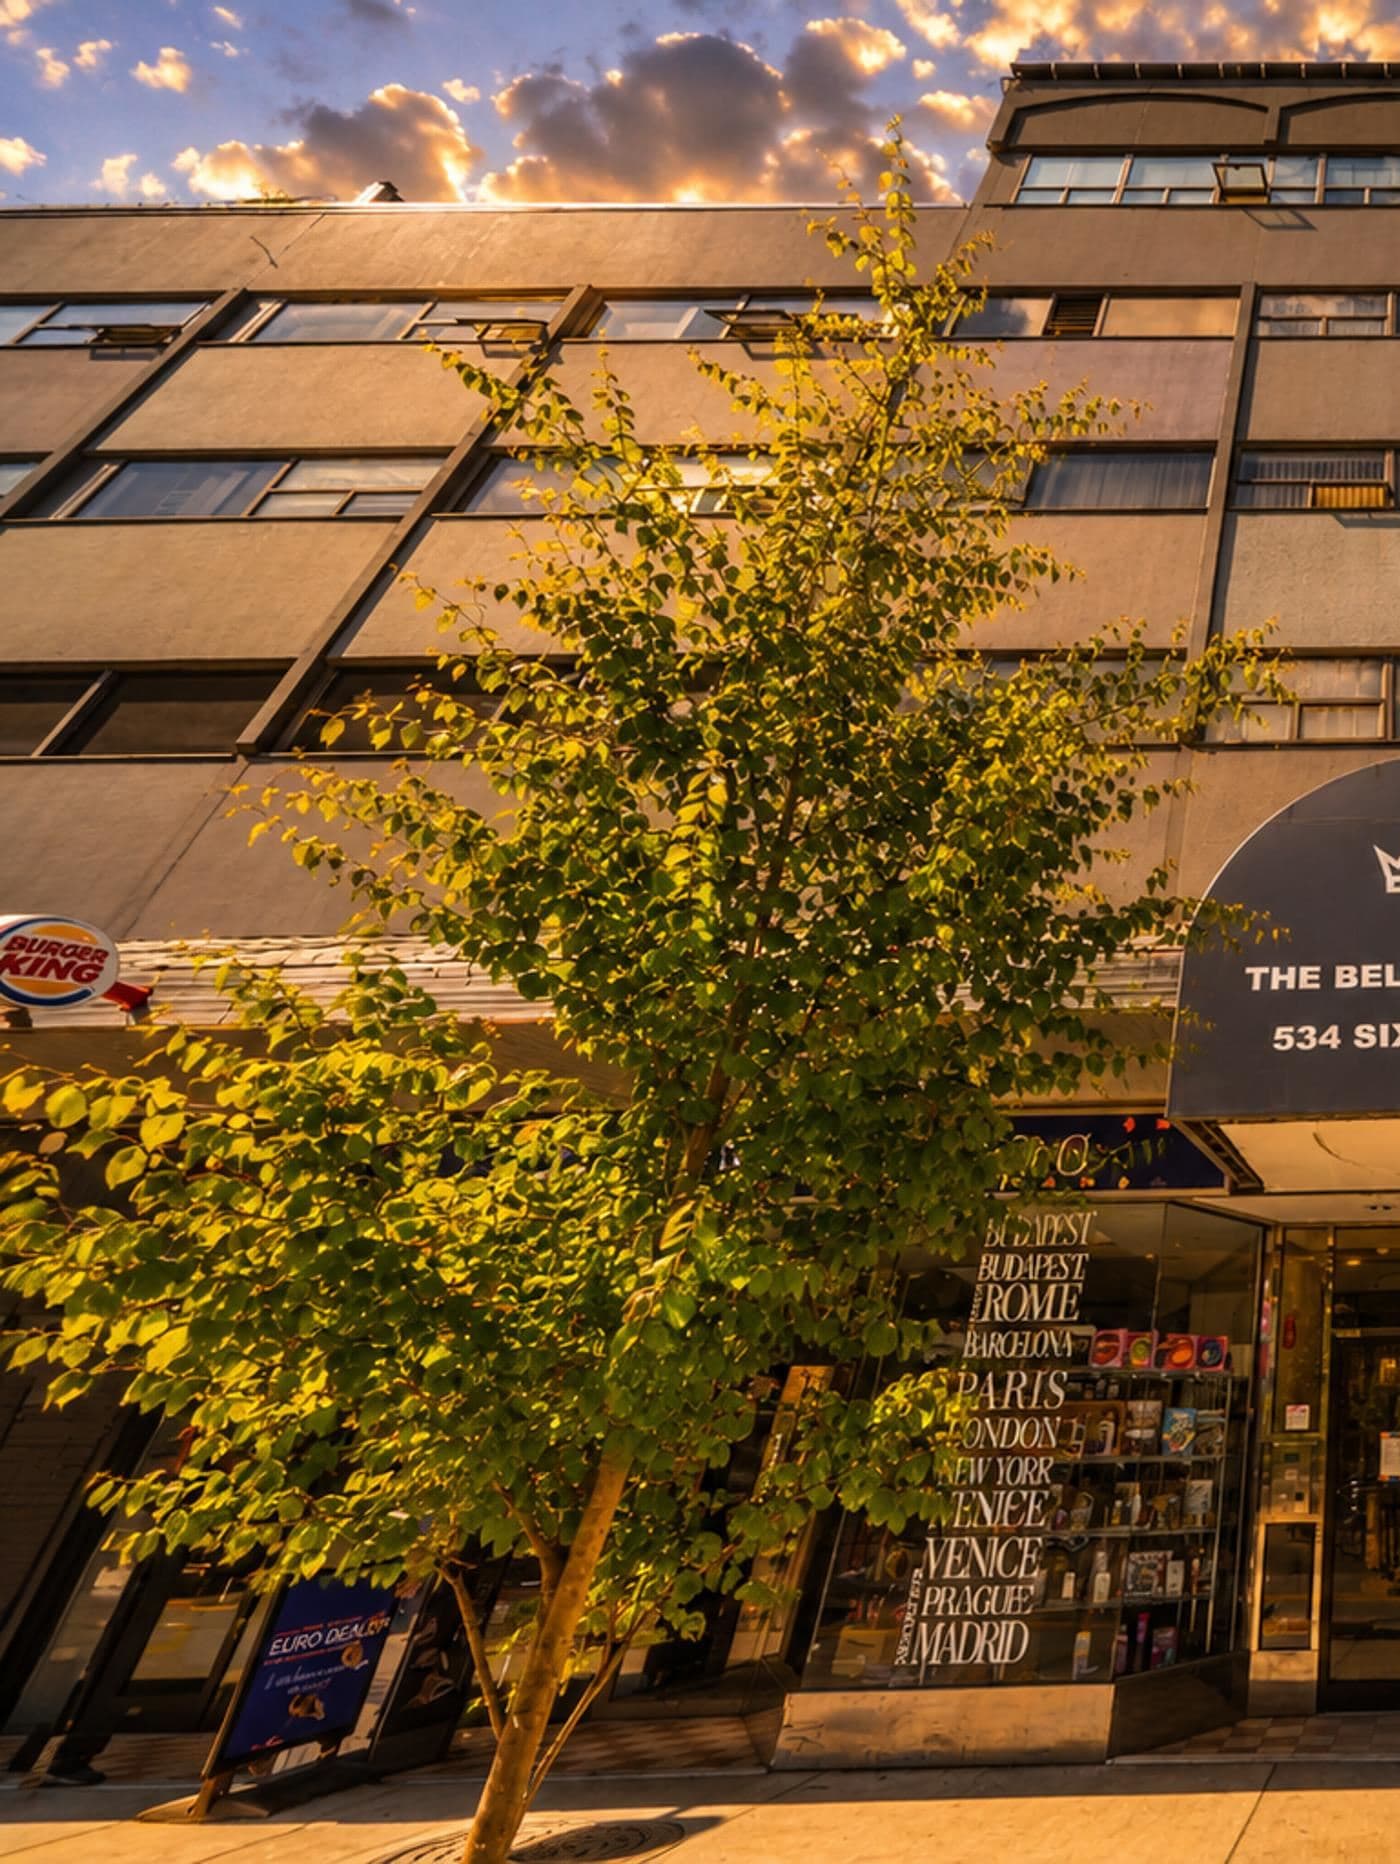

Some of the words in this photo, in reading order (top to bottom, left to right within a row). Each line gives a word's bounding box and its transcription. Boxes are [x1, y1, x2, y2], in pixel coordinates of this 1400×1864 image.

[4, 935, 109, 964] BURGER
[0, 953, 104, 984] KING
[1245, 966, 1321, 991] THE
[1273, 1023, 1341, 1051] 534
[977, 1253, 1090, 1281] BUDAPEST
[977, 1282, 1083, 1322] ROME
[957, 1369, 1068, 1410] PARIS
[922, 1536, 1043, 1580] VENICE
[269, 1631, 323, 1656] EURO
[910, 1620, 1030, 1665] MADRID
